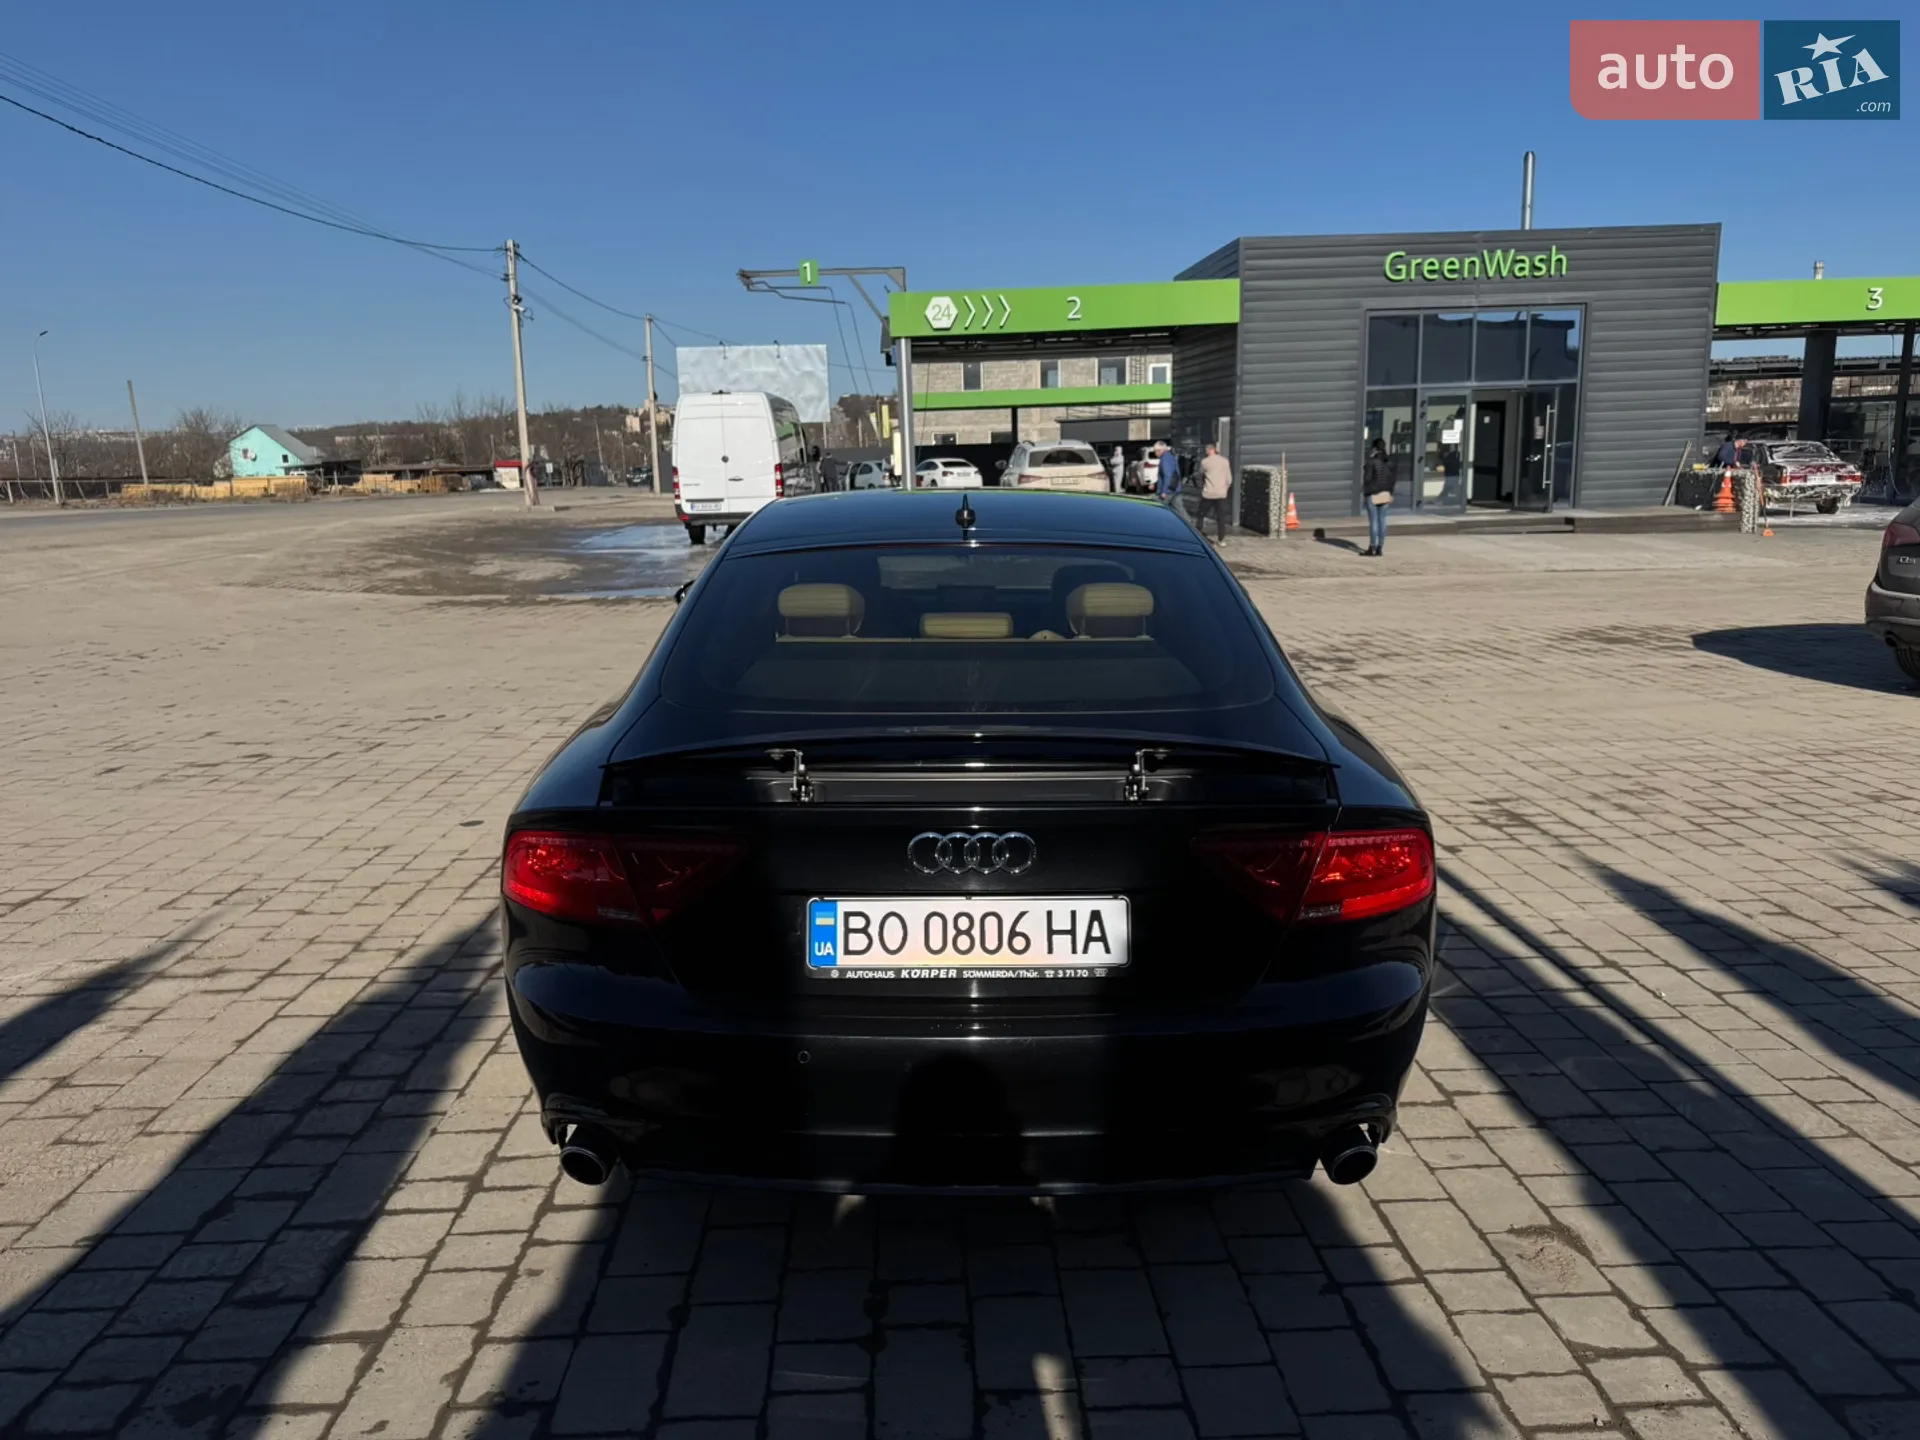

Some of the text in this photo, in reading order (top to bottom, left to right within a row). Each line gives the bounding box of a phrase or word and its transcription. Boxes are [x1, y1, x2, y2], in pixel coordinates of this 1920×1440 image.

[802, 262, 812, 284] 1
[1384, 245, 1567, 281] GreenWash
[931, 296, 1082, 321] 24 2
[1866, 287, 1884, 311] 3
[843, 909, 1112, 956] BO 0806 HA
[815, 943, 835, 957] UA
[846, 970, 895, 979] AUTOHAUS
[900, 968, 957, 979] KÖRPER
